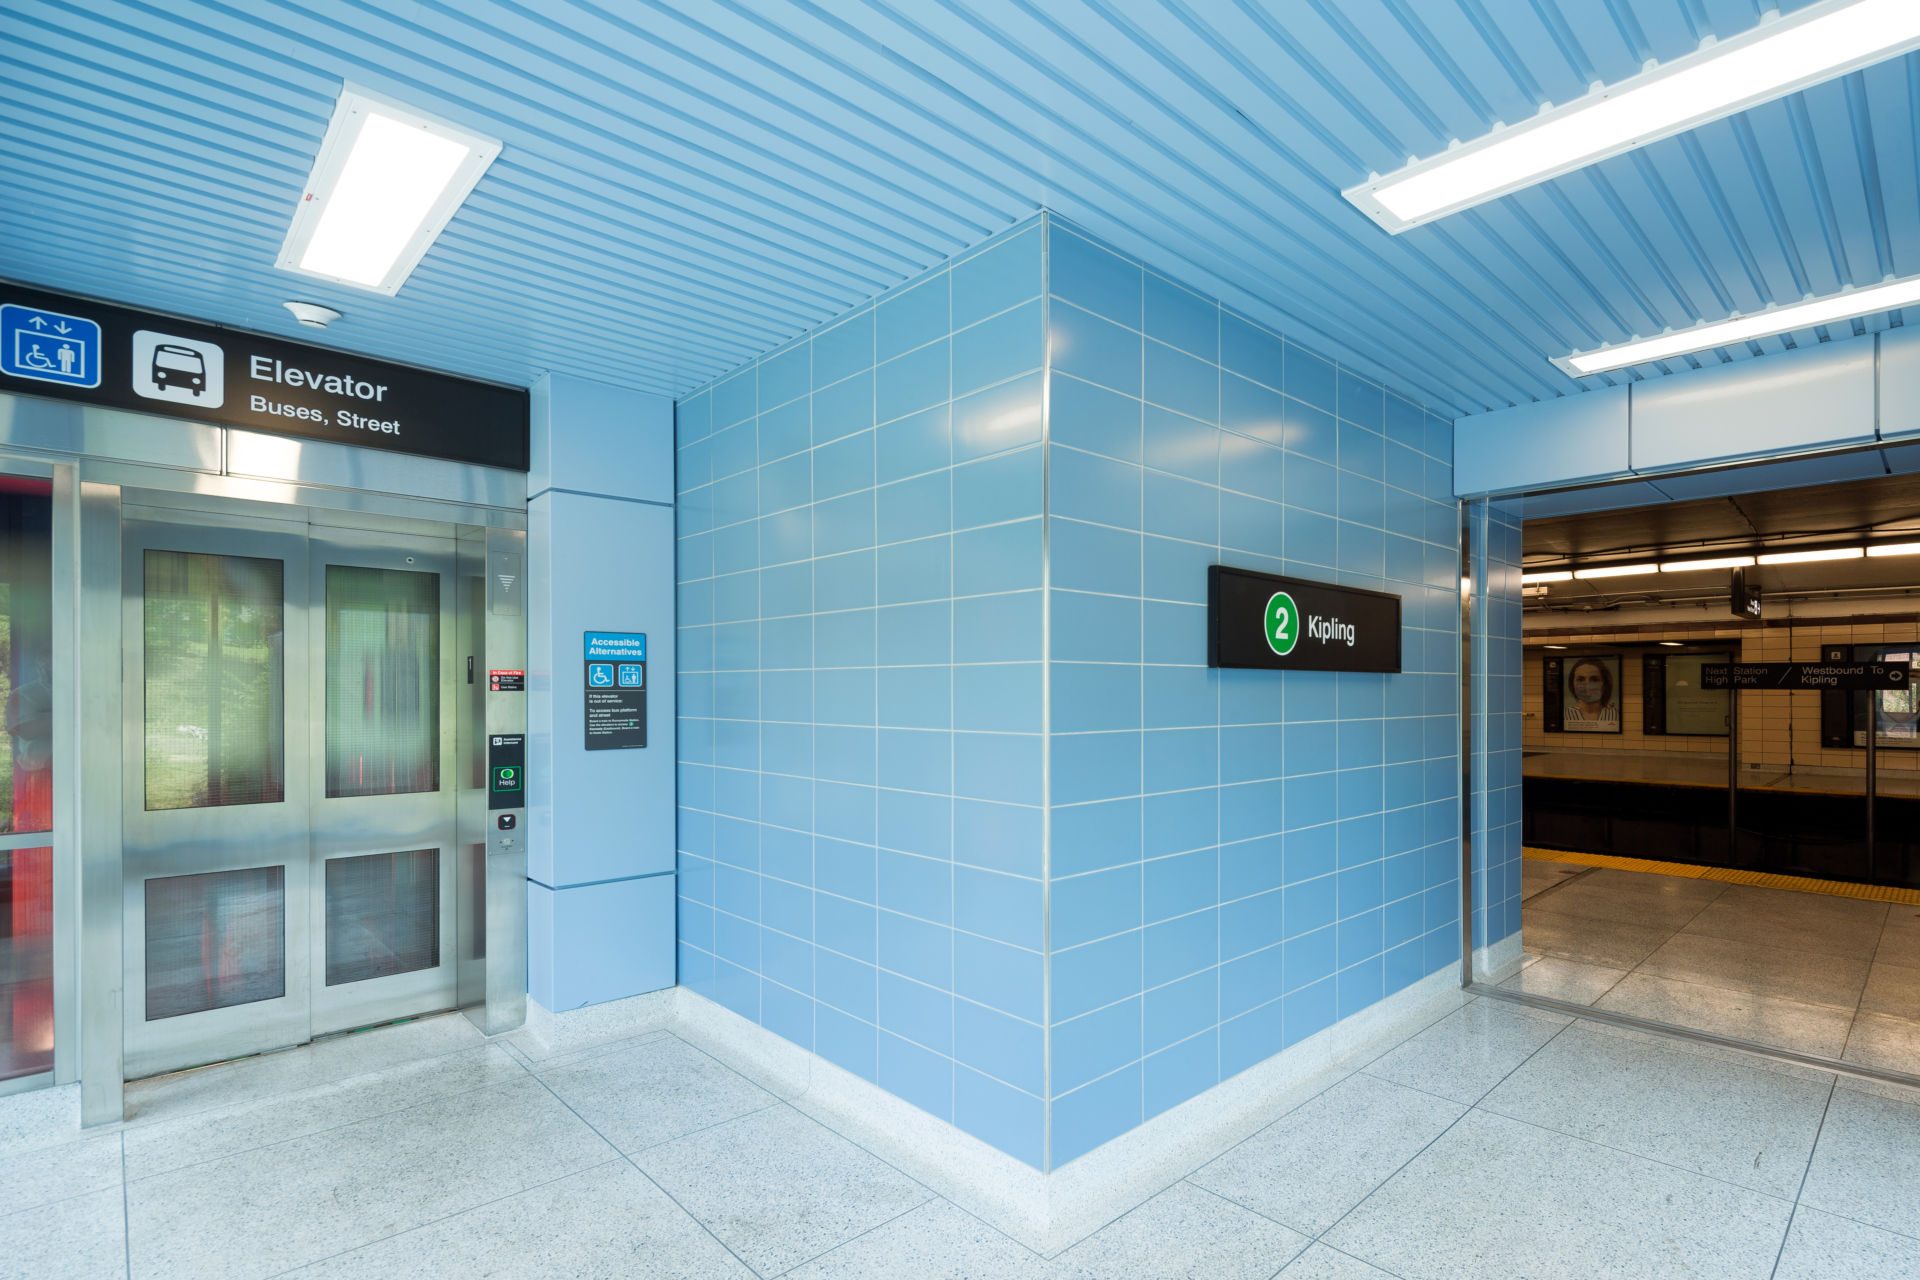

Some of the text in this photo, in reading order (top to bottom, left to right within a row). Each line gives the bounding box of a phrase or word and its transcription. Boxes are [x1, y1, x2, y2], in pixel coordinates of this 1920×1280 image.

[250, 354, 388, 402] Elevator
[250, 394, 401, 435] Buses, Street
[1274, 606, 1355, 647] 2 Kipling
[591, 637, 640, 647] Accessible
[589, 647, 642, 656] Alternatives
[1705, 666, 1768, 675] Next Station
[1802, 665, 1884, 675] Westbound To
[1705, 675, 1757, 686] High Park
[1801, 675, 1838, 686] Kipling
[498, 779, 516, 787] Help
